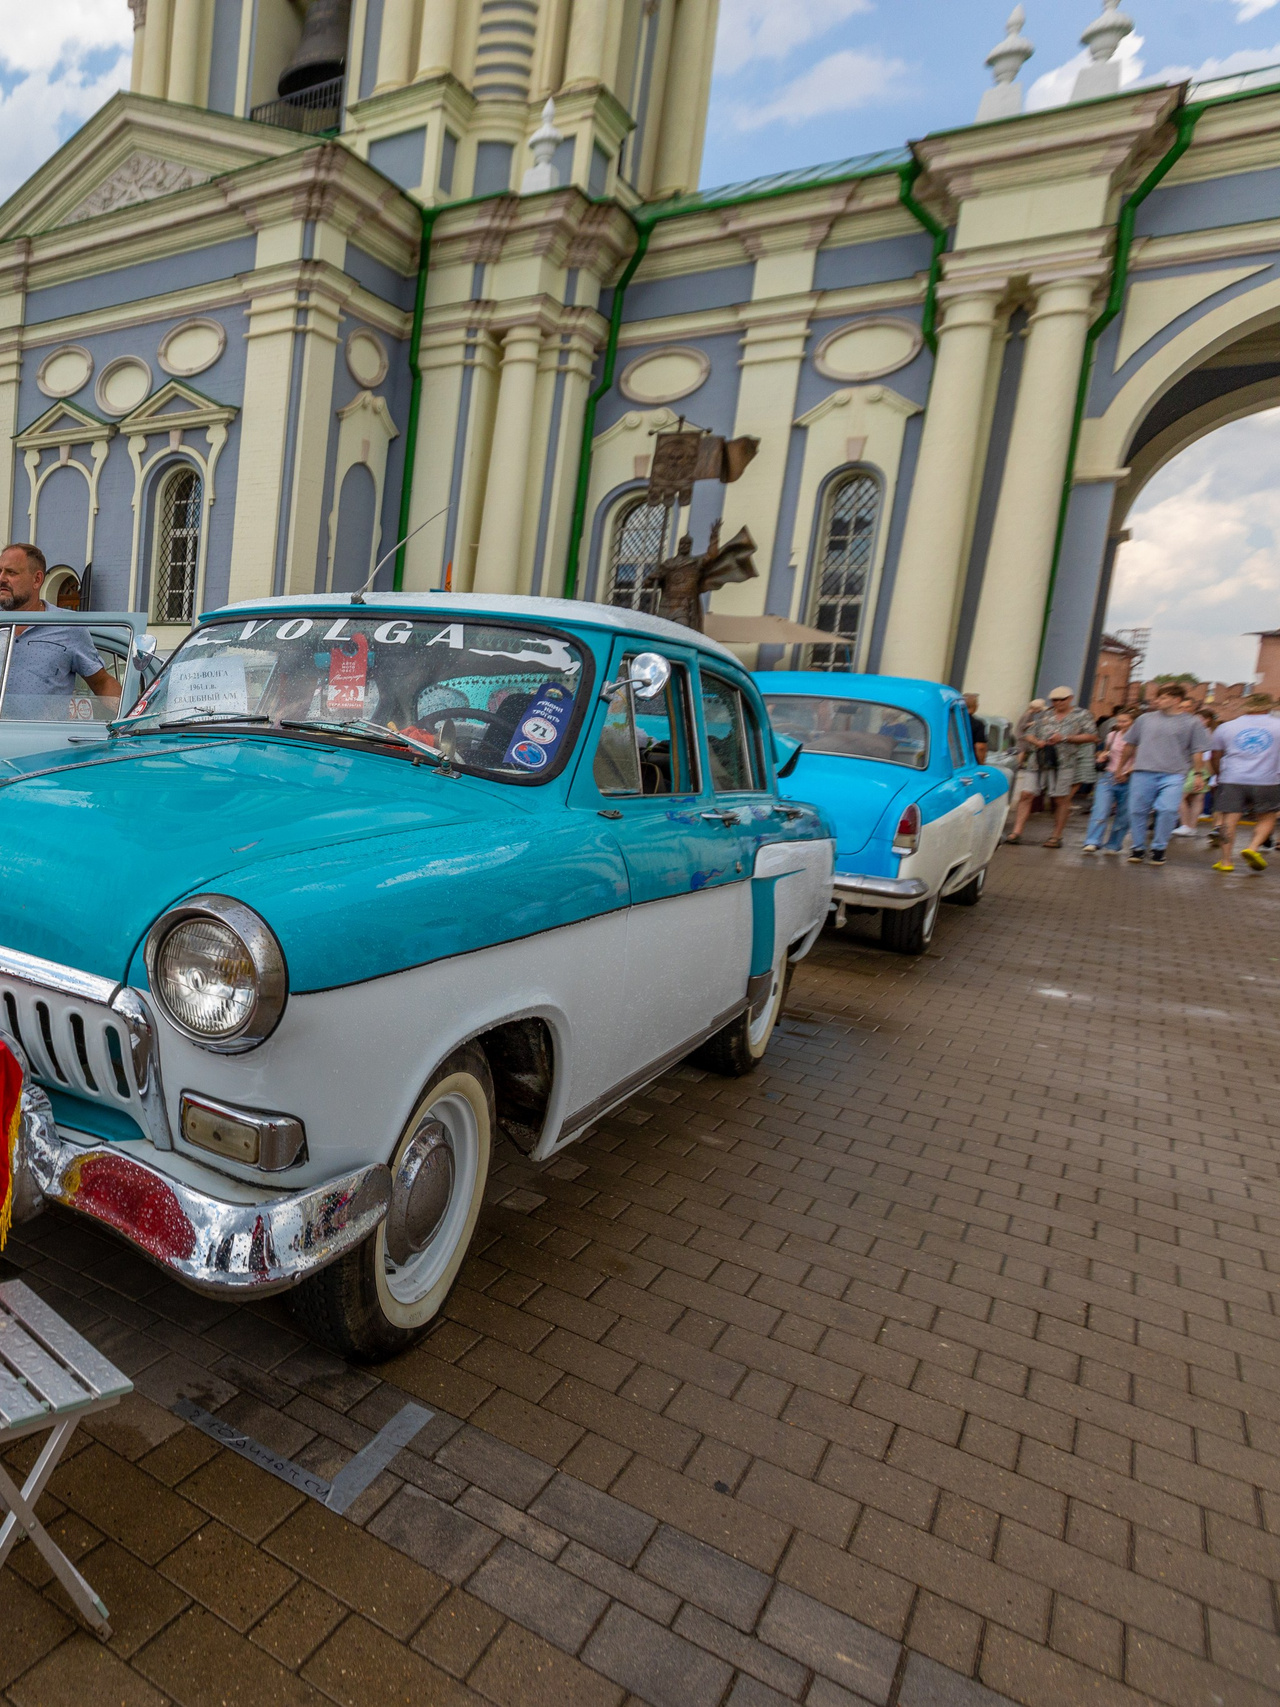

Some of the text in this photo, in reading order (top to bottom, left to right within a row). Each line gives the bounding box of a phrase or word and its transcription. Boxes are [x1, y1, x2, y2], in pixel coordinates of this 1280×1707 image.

[239, 618, 464, 649] VOLGA
[536, 700, 564, 713] РУКАМИ
[543, 706, 553, 714] НЕ
[532, 709, 560, 723] ТРОГАТЬ
[531, 723, 549, 738] 71
